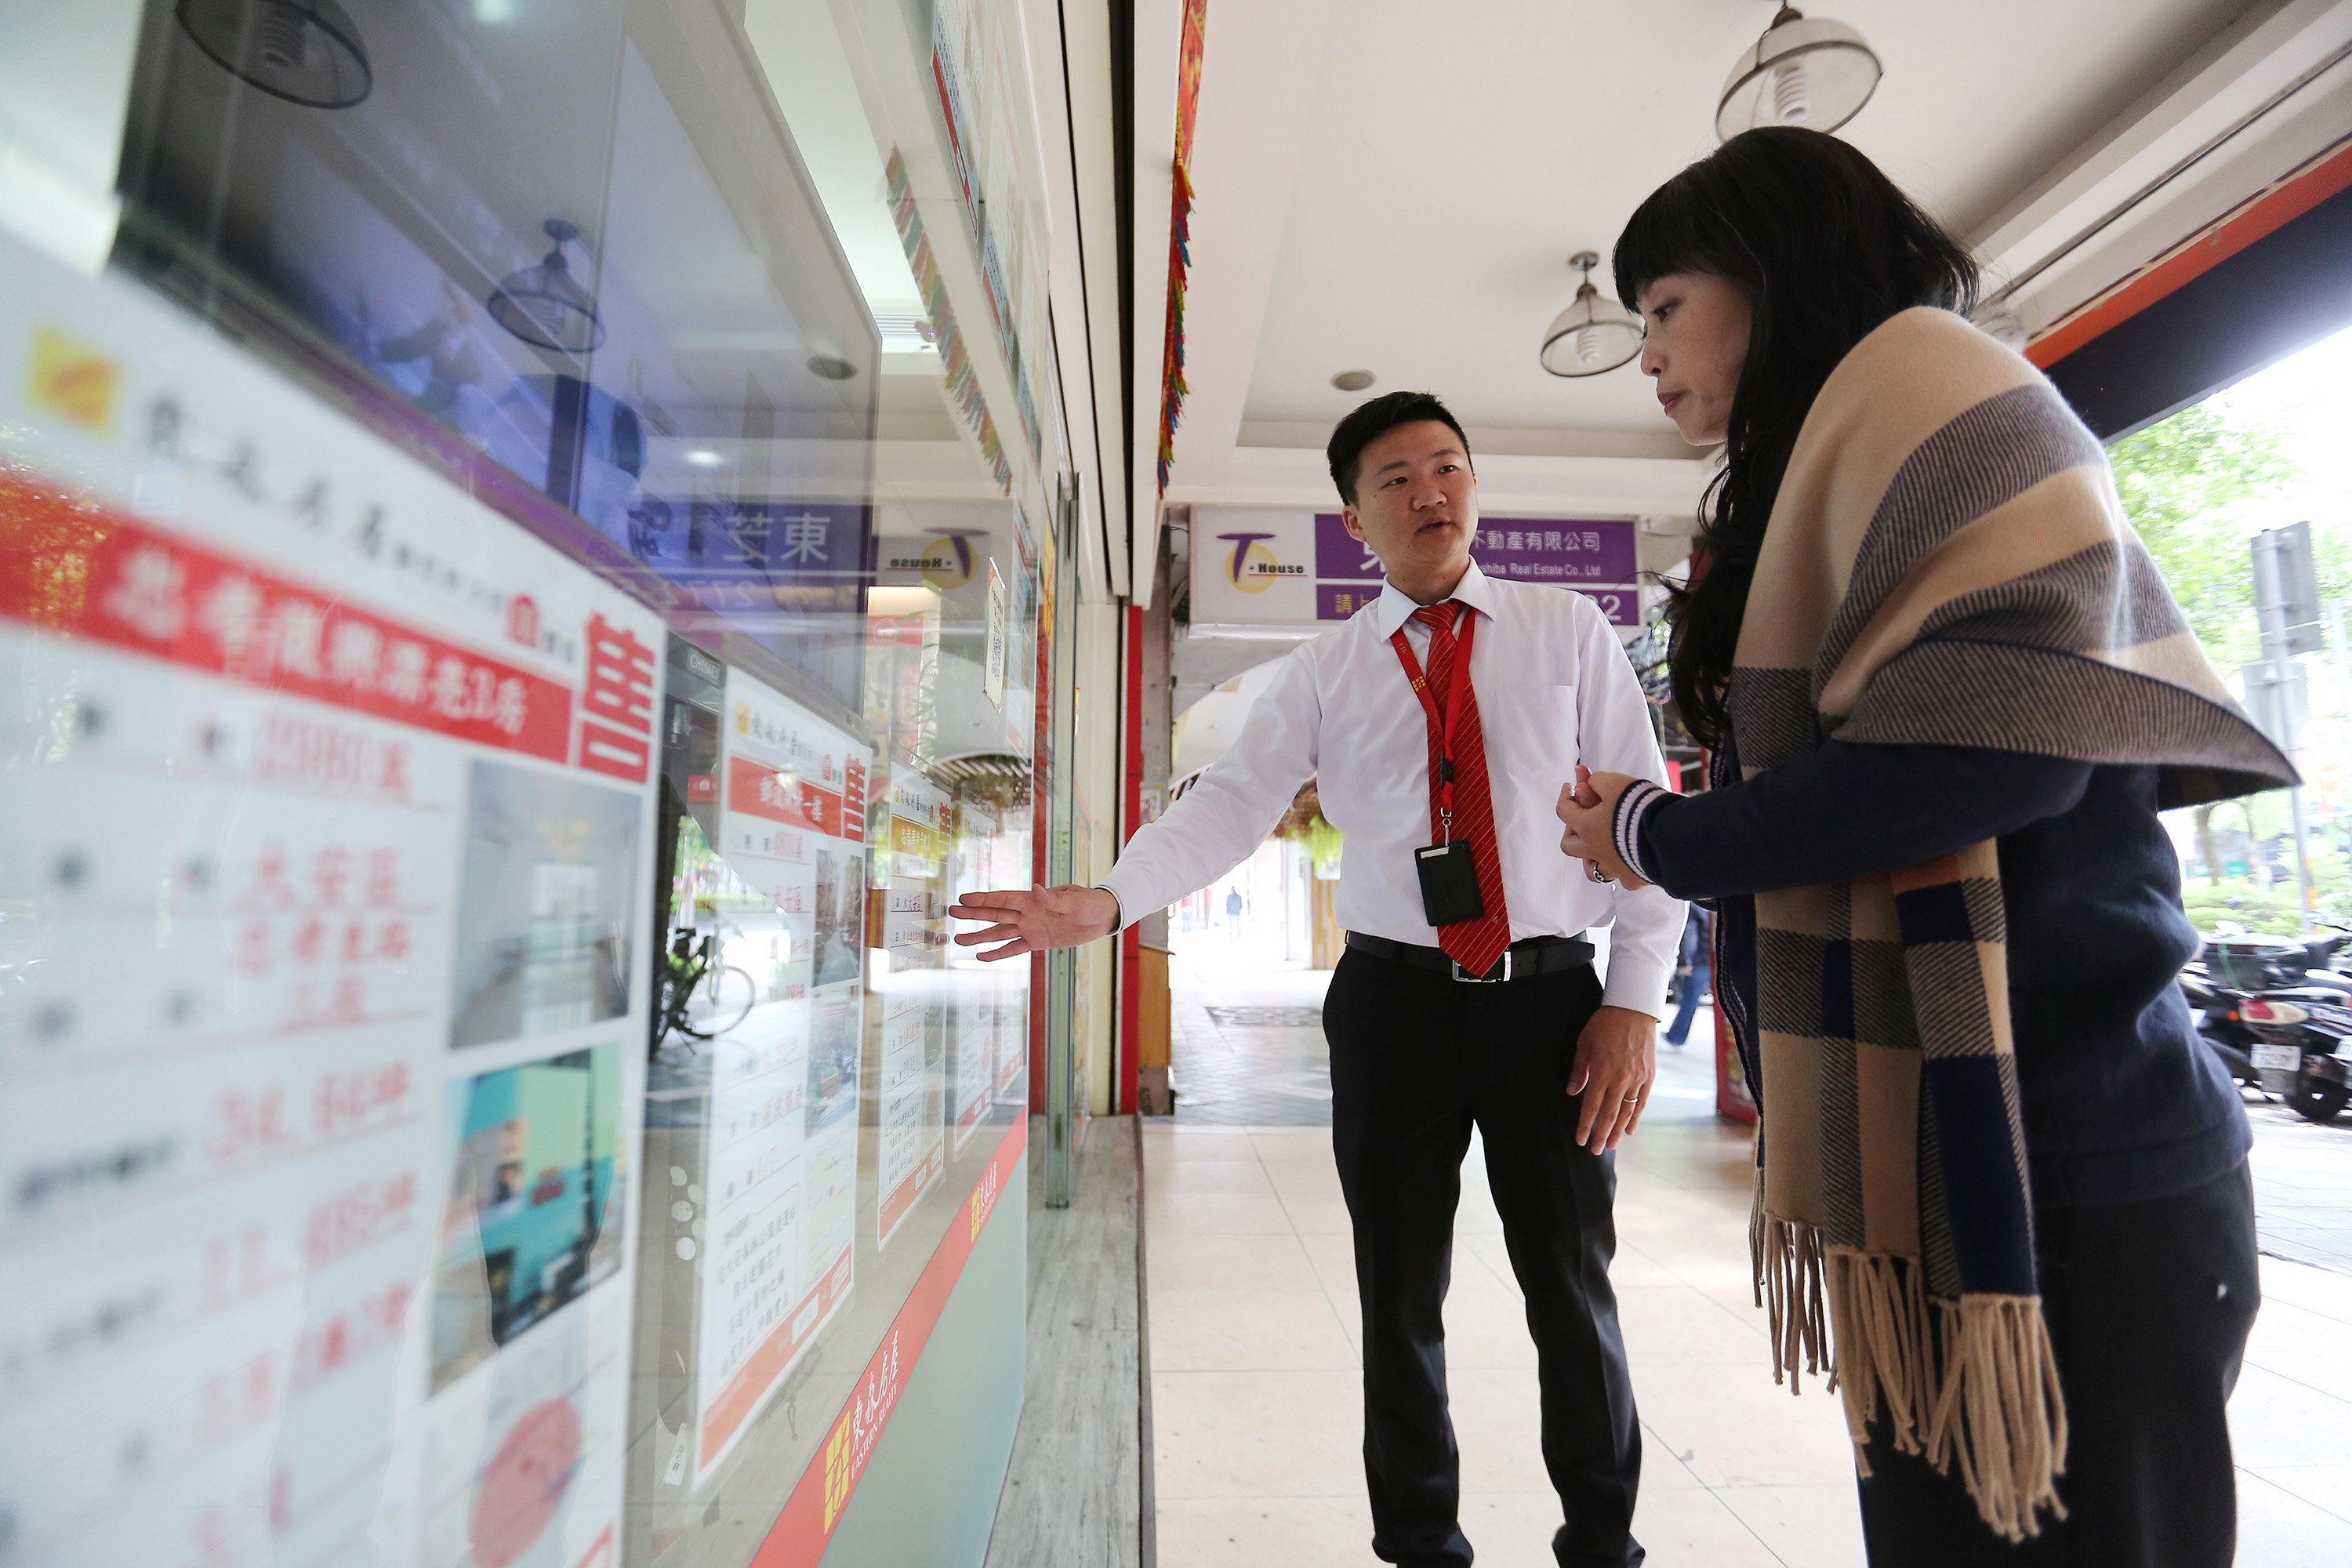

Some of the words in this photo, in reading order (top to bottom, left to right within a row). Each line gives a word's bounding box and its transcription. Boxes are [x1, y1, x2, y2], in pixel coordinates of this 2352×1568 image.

[1258, 563, 1305, 574] House
[1480, 563, 1507, 575] shiba
[1510, 563, 1532, 575] Real
[1534, 563, 1563, 575] Estate
[689, 653, 719, 681] CHIMEI
[851, 1417, 878, 1480] EASTERN
[878, 1381, 898, 1421] REALTY
